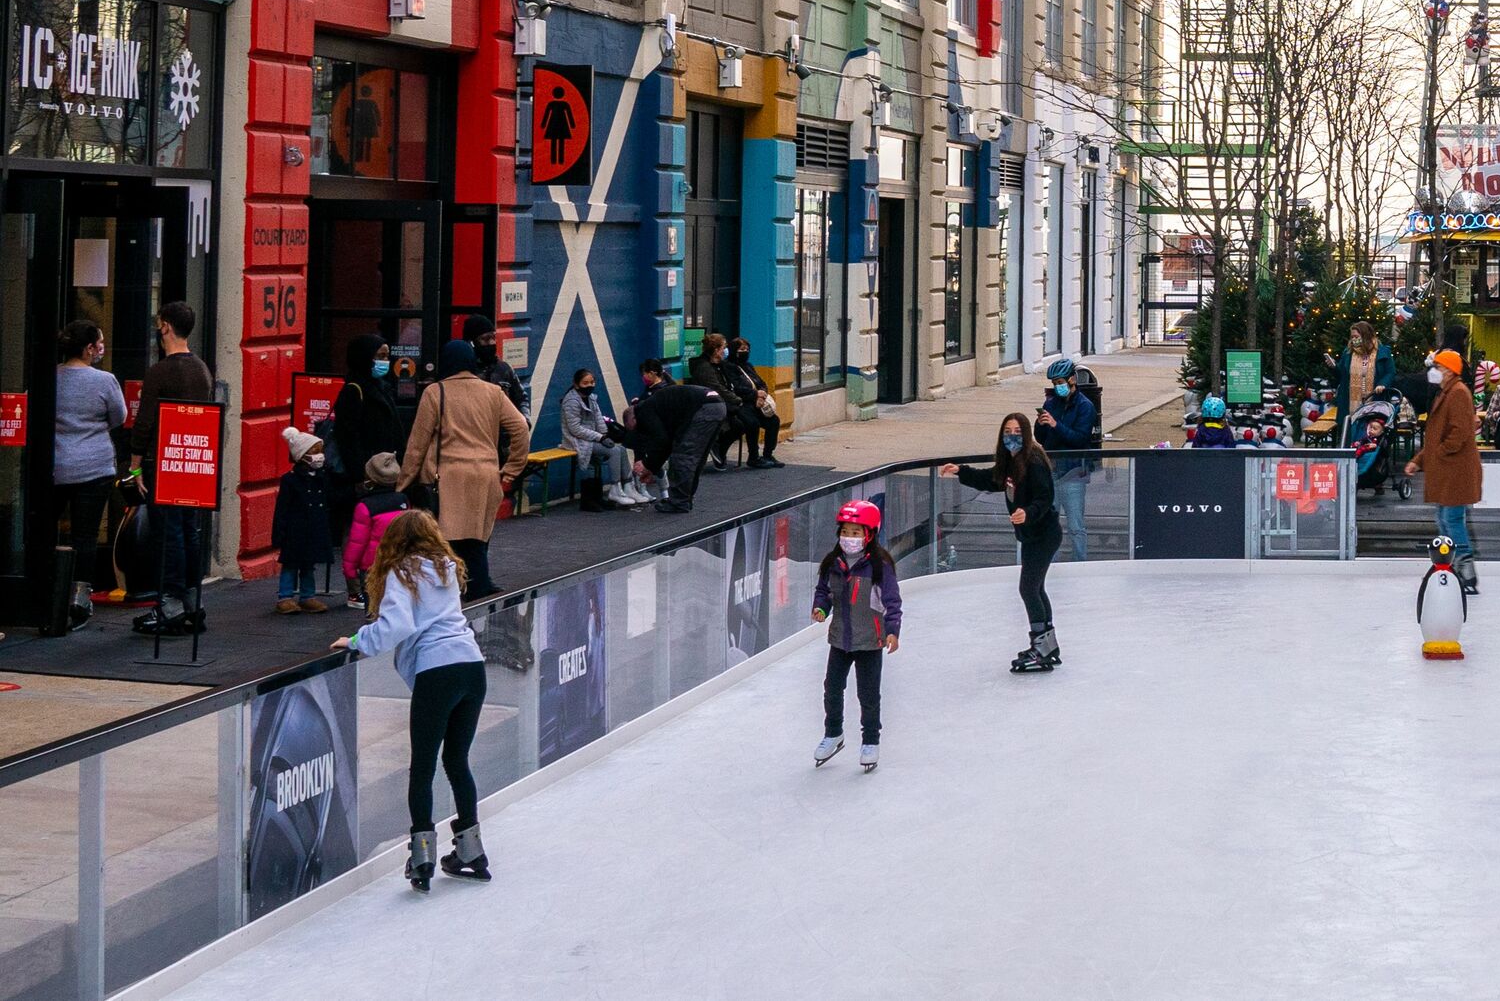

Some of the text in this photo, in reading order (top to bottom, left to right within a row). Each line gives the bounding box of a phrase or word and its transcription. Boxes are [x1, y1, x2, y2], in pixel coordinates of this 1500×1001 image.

[70, 32, 97, 95] ICE
[101, 36, 141, 99] RINK
[63, 102, 123, 118] VOLVO
[253, 228, 307, 246] COURTYARD
[505, 292, 523, 301] WOMEN
[263, 286, 297, 328] 5/6
[310, 399, 330, 410] HOURS
[170, 433, 209, 447] ALL SKATES
[164, 447, 213, 461] MUST STAY ON
[161, 460, 215, 475] BLACK MATTING
[1158, 505, 1222, 513] VOLVO
[744, 570, 761, 601] FUTURE
[1440, 574, 1448, 585] 3
[558, 645, 587, 685] CREATES
[277, 751, 334, 812] BROOKLYN
